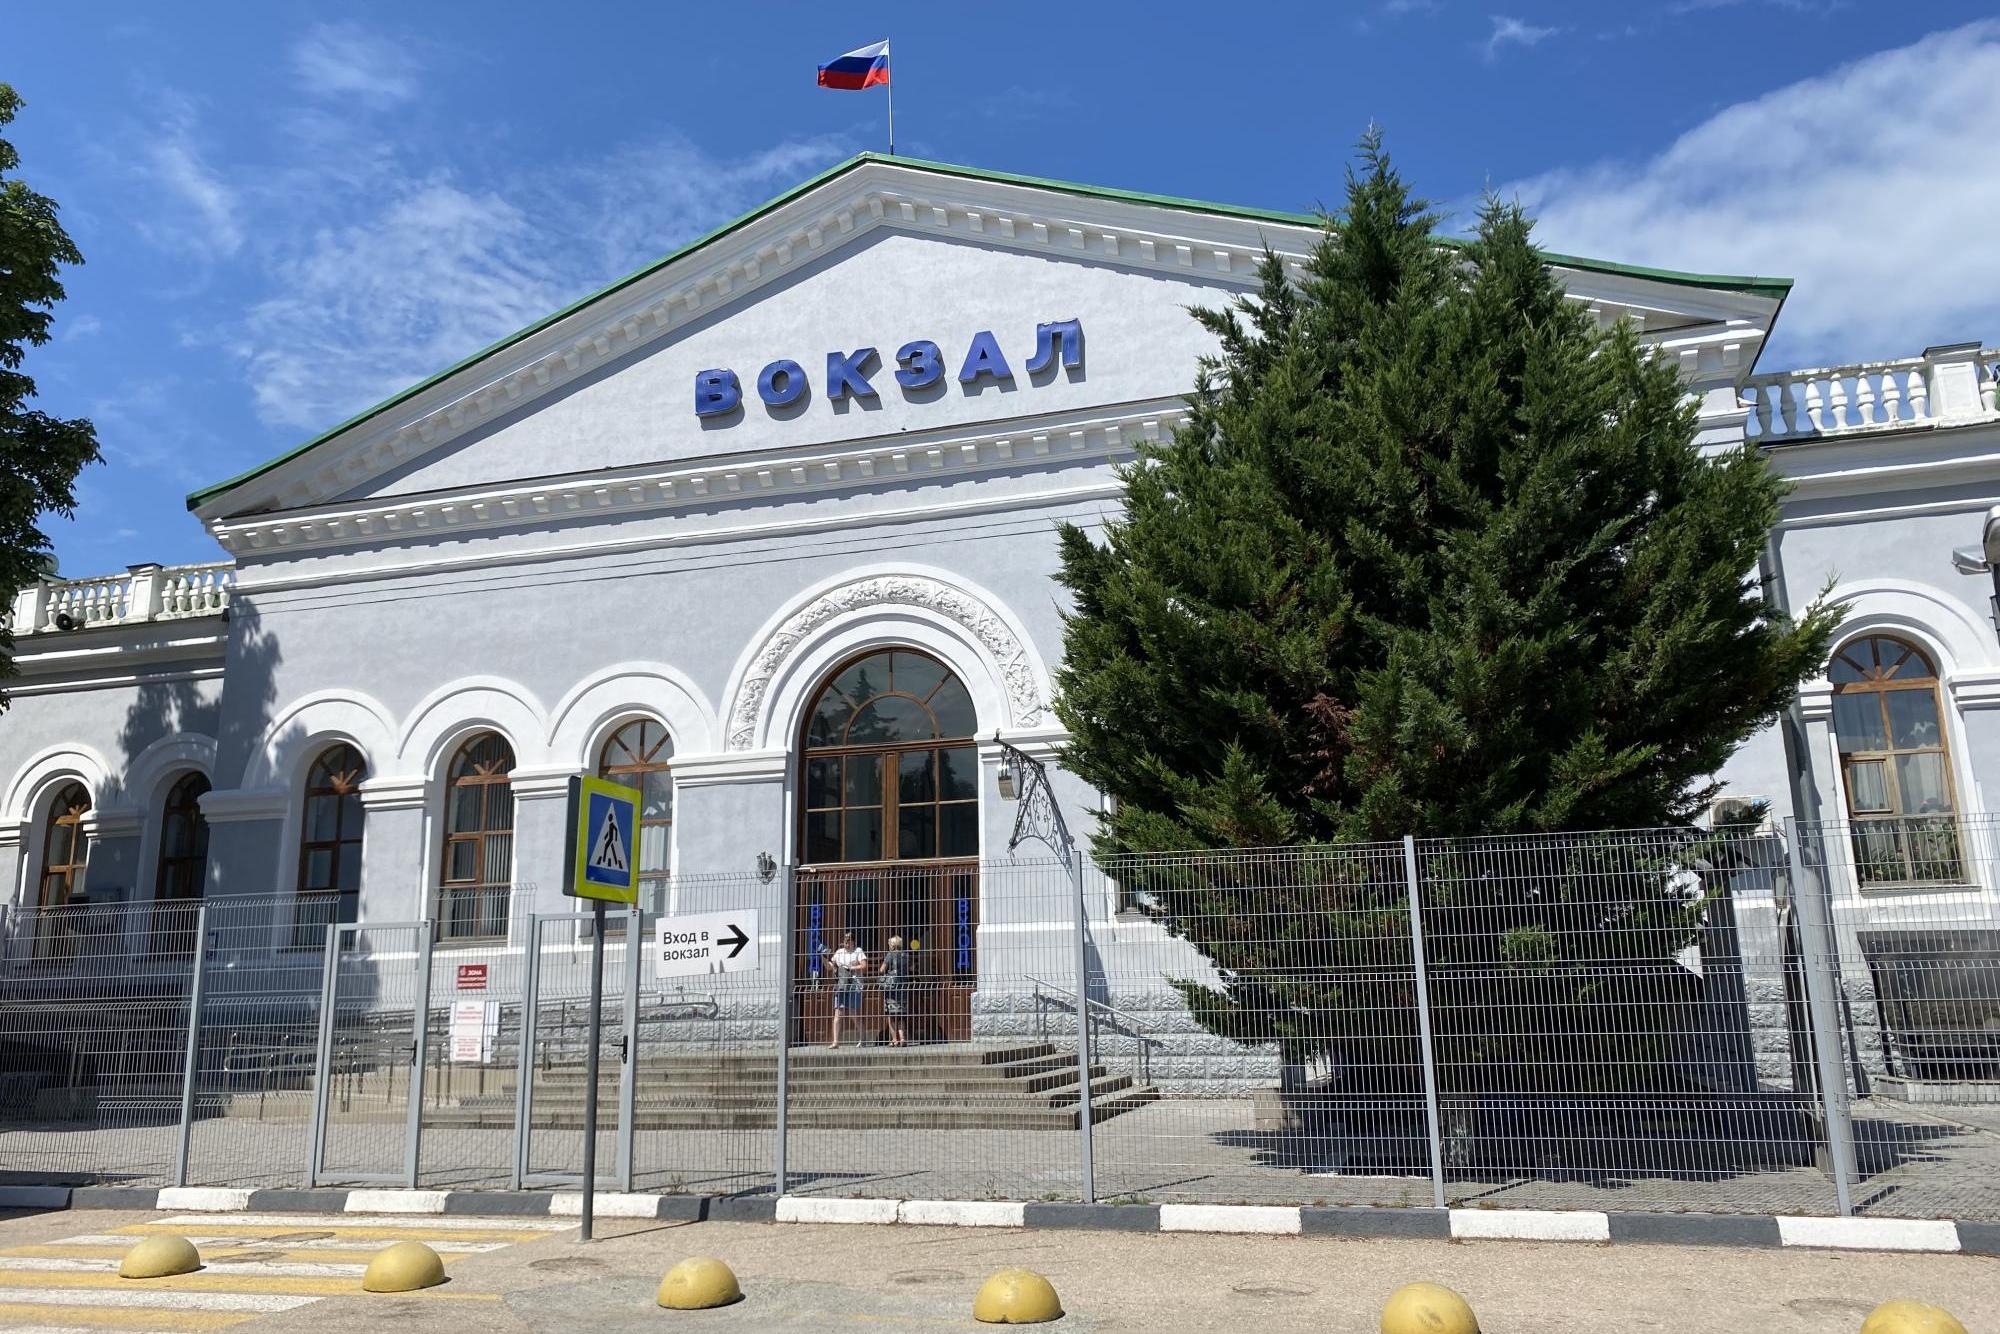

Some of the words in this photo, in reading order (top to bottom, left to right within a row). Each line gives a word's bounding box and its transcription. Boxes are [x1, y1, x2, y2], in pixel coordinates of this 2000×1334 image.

[695, 318, 1081, 416] ВОКЗАЛ
[663, 932, 697, 945] Вход
[701, 931, 709, 941] в
[663, 948, 709, 961] вокзал
[958, 897, 970, 969] ВХОД
